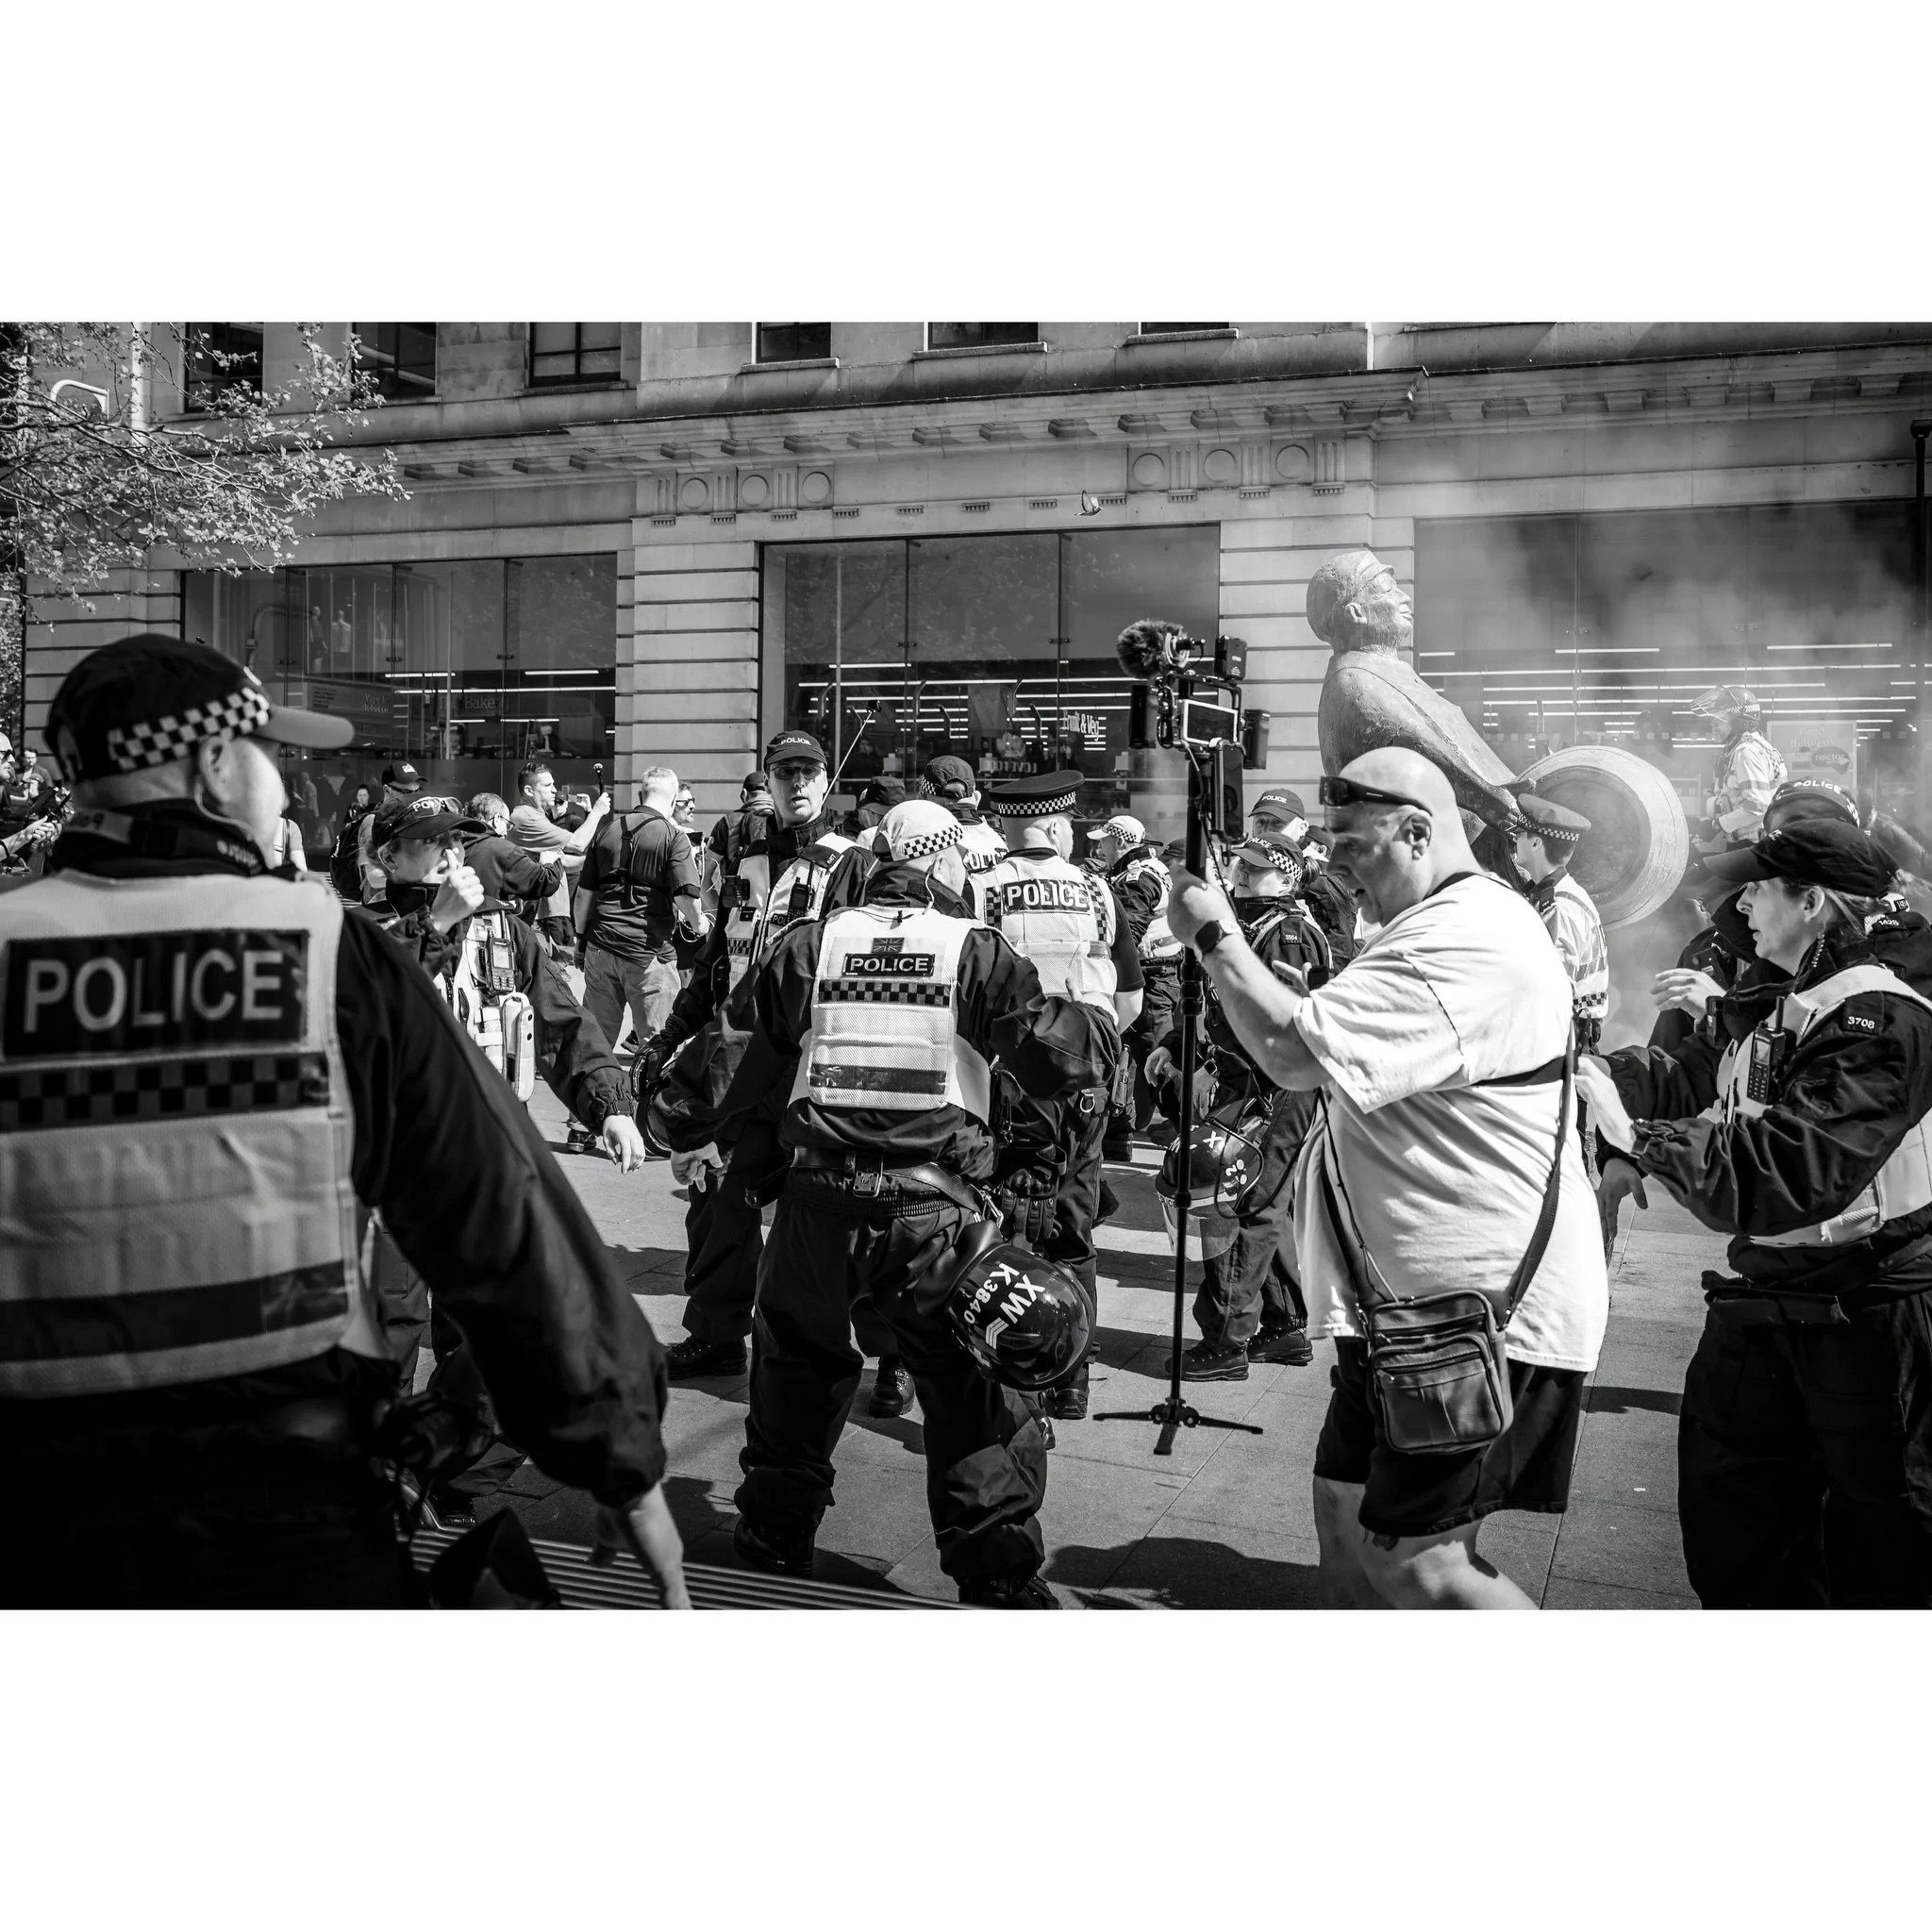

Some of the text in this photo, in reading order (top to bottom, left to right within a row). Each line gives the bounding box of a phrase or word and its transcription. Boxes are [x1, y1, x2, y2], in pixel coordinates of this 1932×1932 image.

[1080, 713, 1087, 734] &
[1087, 714, 1100, 741] Veg
[780, 737, 811, 746] POLICE
[1793, 779, 1842, 794] POLICE
[1262, 794, 1288, 804] POLICE
[1007, 882, 1089, 909] POLICE
[850, 958, 929, 972] POLICE
[24, 948, 283, 1034] POLICE
[1847, 1016, 1875, 1029] 3708
[1000, 1274, 1046, 1324] XW
